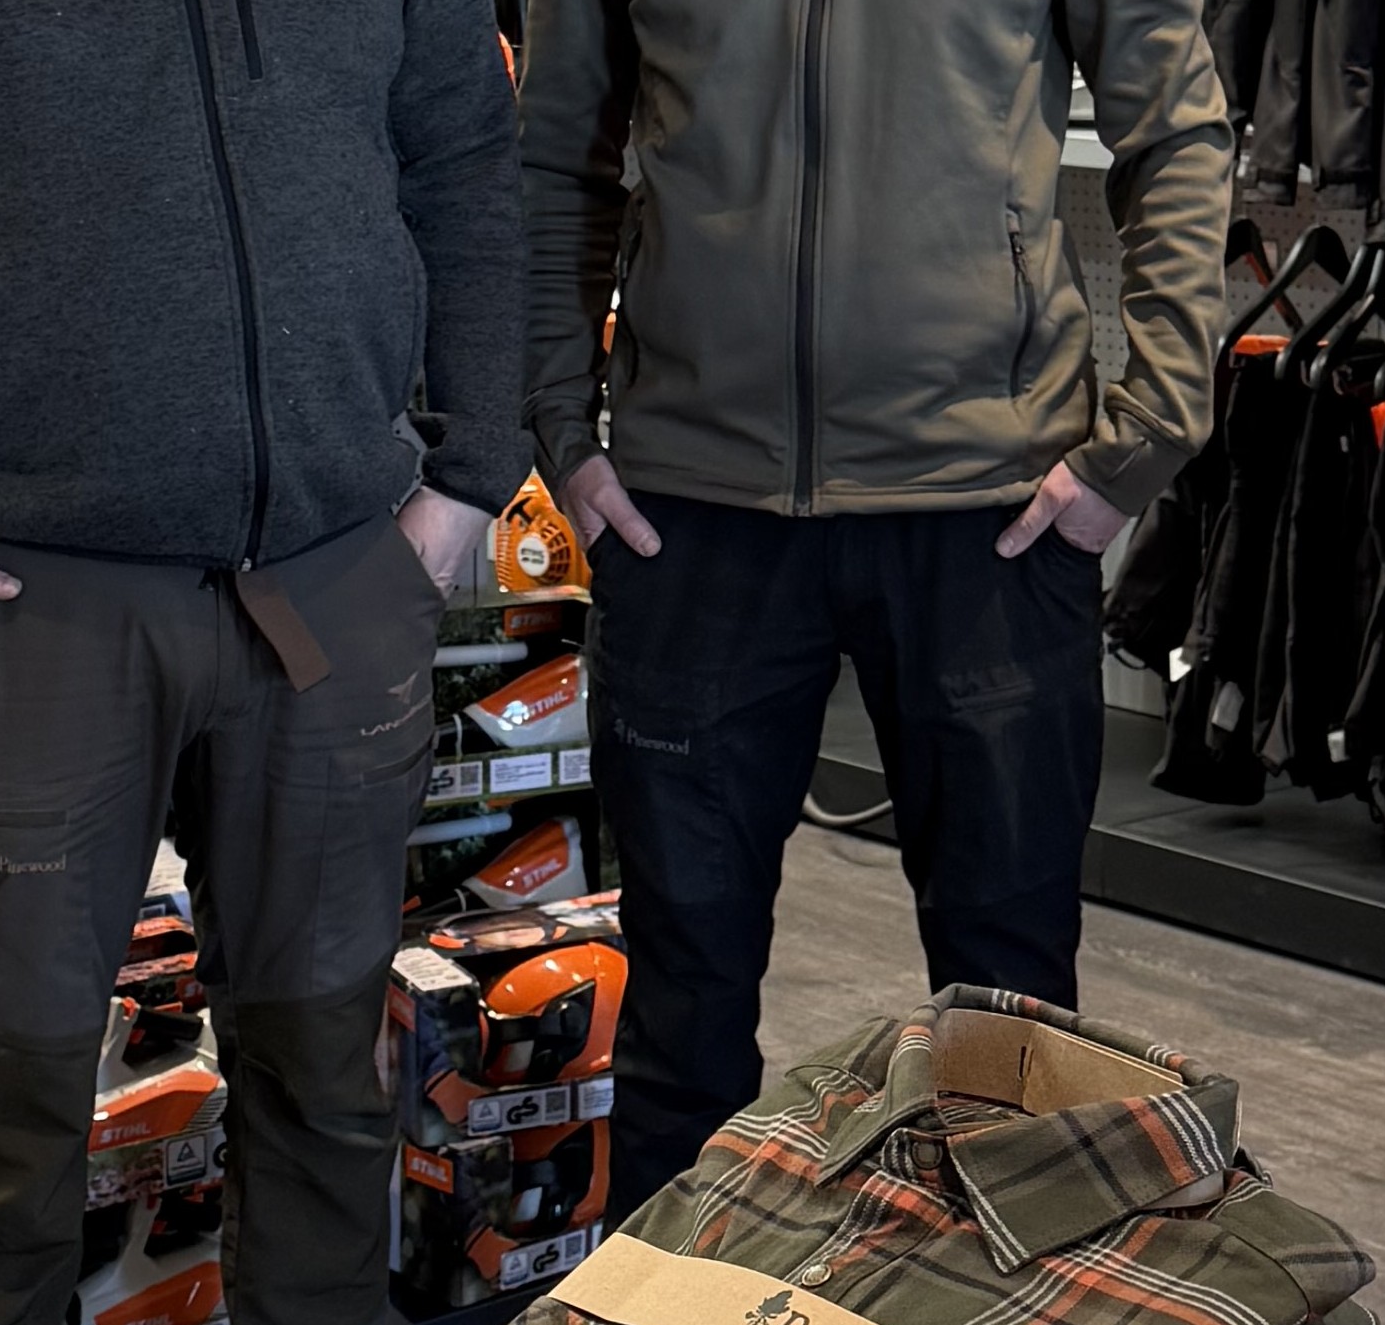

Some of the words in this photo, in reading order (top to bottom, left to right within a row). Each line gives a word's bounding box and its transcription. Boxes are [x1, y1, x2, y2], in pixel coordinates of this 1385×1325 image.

[527, 690, 569, 717] STIHL
[626, 729, 690, 756] Pinewood
[100, 1122, 152, 1145] STIHL
